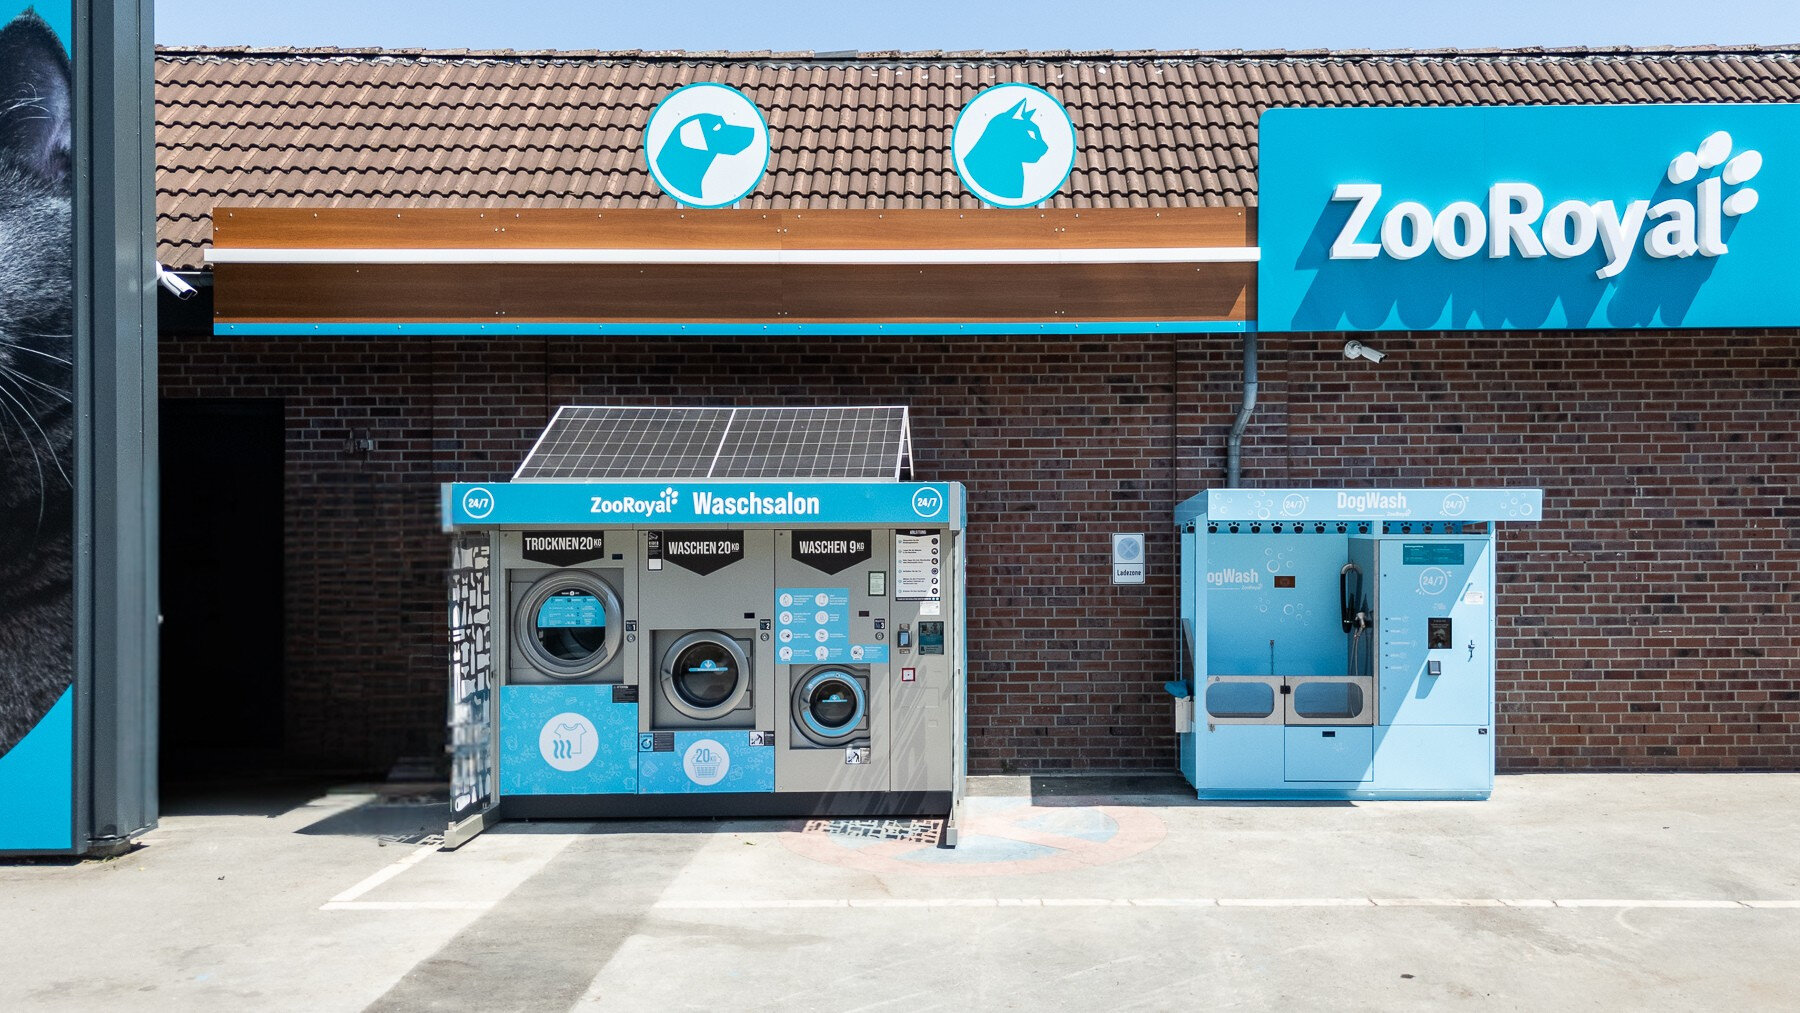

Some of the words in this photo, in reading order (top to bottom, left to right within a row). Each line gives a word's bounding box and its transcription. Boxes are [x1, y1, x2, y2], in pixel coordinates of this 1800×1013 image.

[1329, 176, 1729, 279] ZooRoyal
[468, 498, 488, 509] 24/7
[590, 495, 672, 517] ZooRoyal
[692, 491, 819, 515] Waschsalon
[917, 497, 937, 509] 24/7
[1285, 500, 1303, 509] 24/7
[1337, 491, 1407, 512] DogWash
[1445, 500, 1463, 509] 24/7
[525, 537, 581, 550] TROCKNEN
[668, 541, 717, 554] WASCHEN
[800, 540, 847, 554] WASCHEN
[1207, 568, 1259, 586] ogWash
[1423, 575, 1444, 586] 24/7
